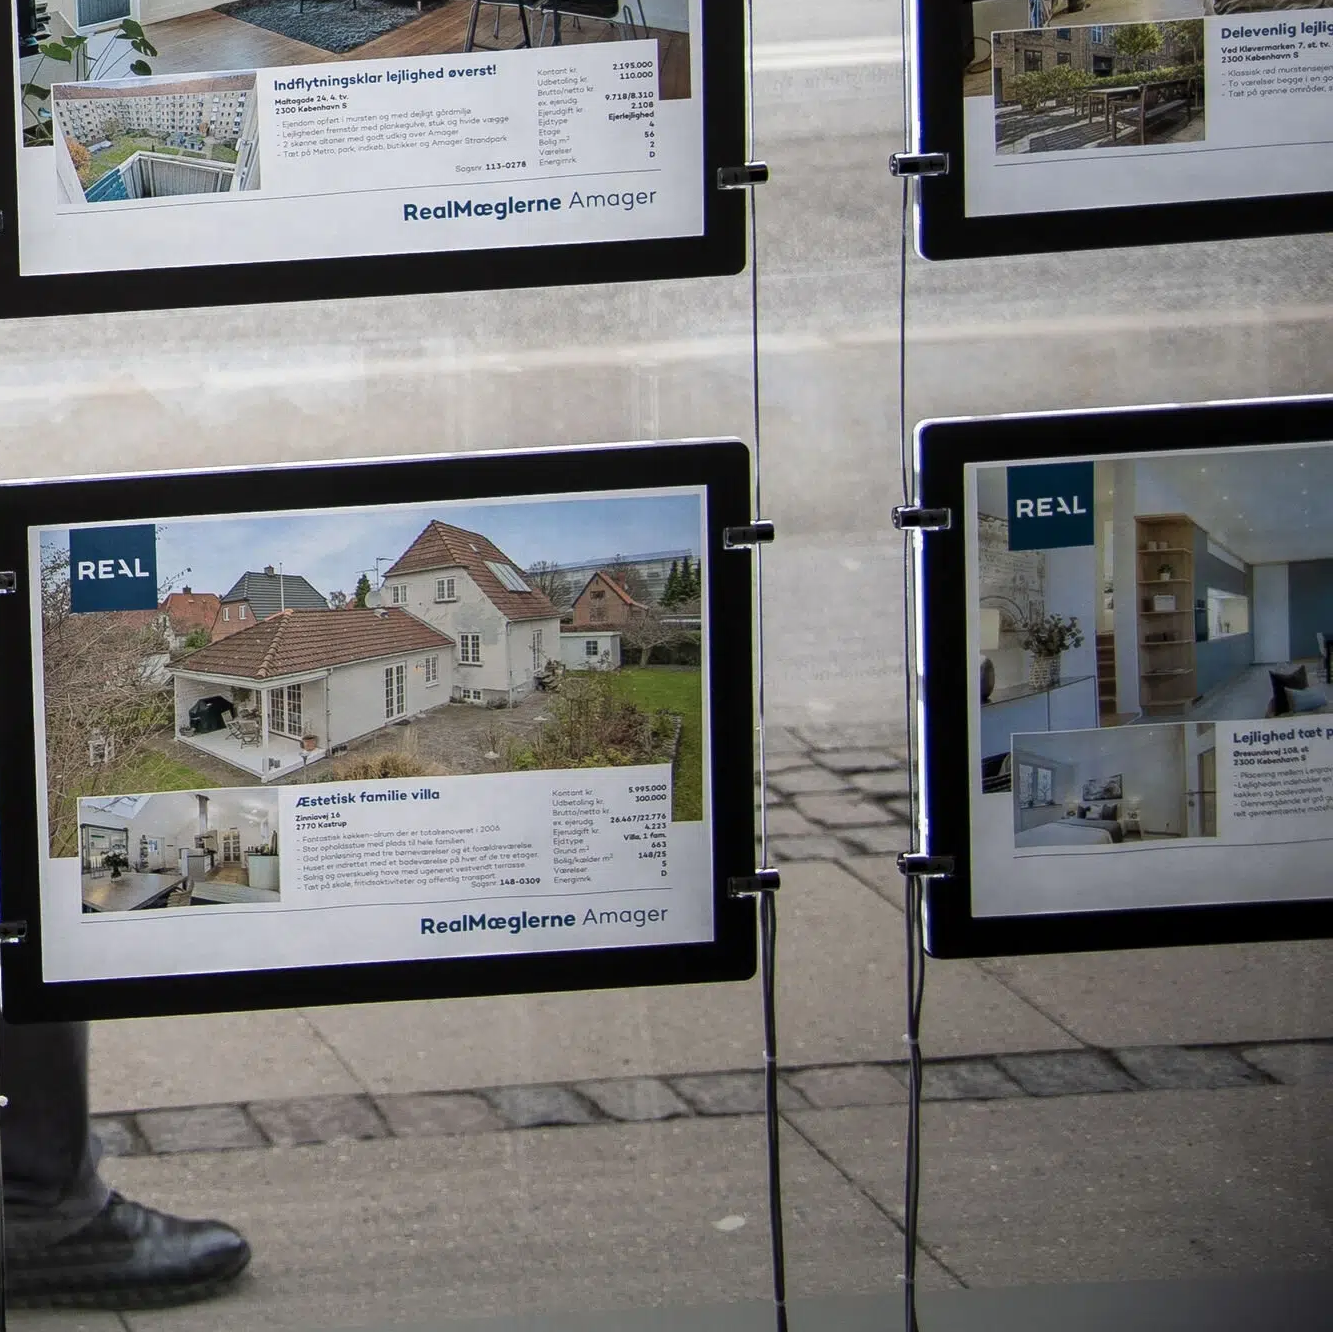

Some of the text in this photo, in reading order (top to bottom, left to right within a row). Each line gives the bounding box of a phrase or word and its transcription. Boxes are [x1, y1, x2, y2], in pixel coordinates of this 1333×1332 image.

[1220, 22, 1297, 39] Delevenlig
[612, 60, 653, 70] 2.195.000
[273, 63, 496, 92] Indflytningsklar lejlighed øverst!
[485, 160, 526, 170] 113-0278
[403, 190, 657, 221] RealMæglerne Amager
[1016, 495, 1086, 518] REAL
[78, 557, 150, 581] REAL
[1233, 728, 1295, 746] Lejlighed
[1297, 726, 1323, 739] tæt
[295, 788, 440, 808] Æstetisk familie villa
[628, 783, 667, 793] 5.995.000
[295, 822, 316, 830] 2770
[499, 877, 541, 886] 148-0309
[420, 908, 668, 934] RealMæglerne Amager
